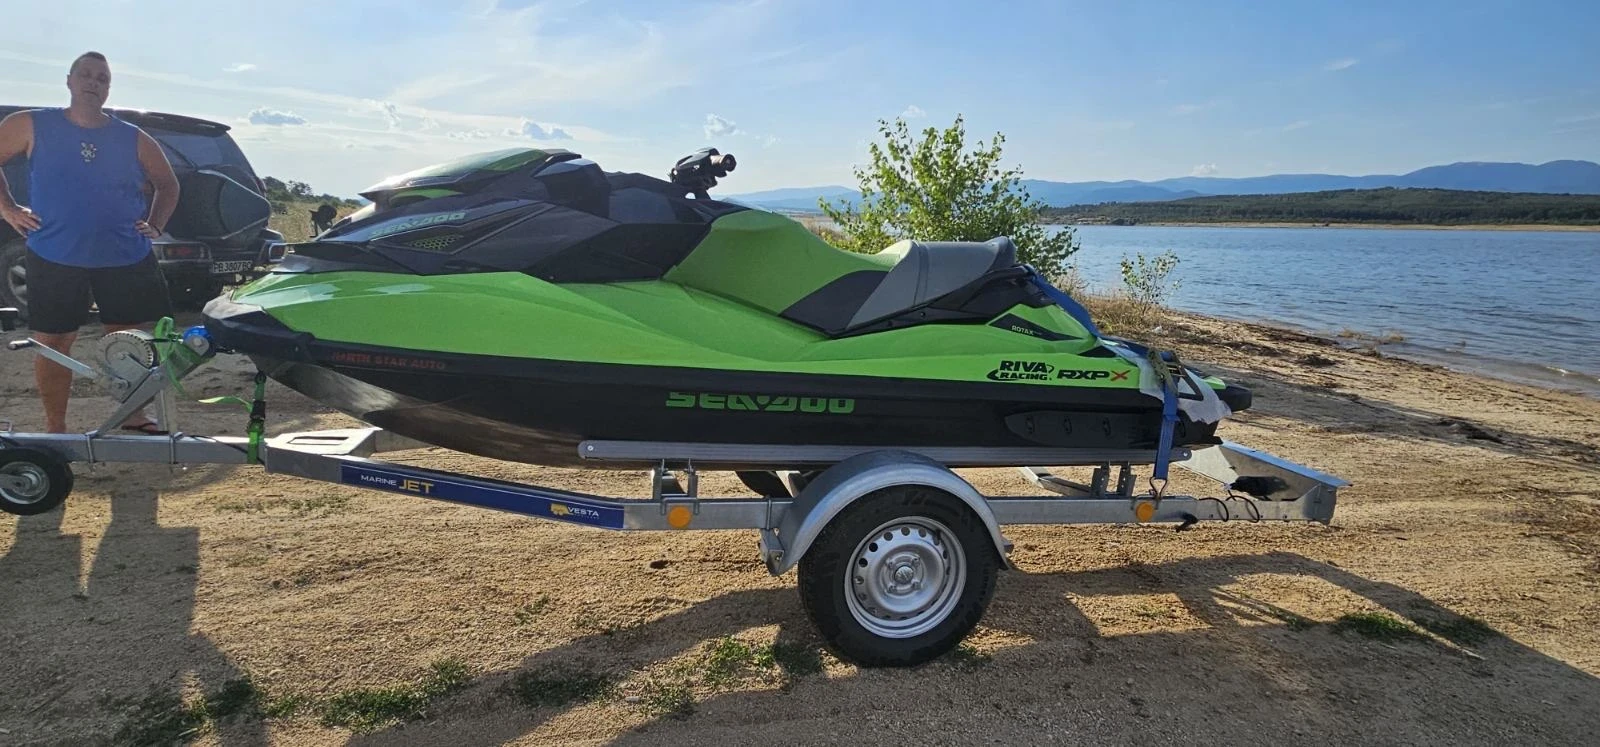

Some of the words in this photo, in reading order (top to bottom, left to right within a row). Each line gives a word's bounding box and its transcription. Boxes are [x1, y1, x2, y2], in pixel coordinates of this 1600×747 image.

[1011, 325, 1034, 336] ROTAX
[375, 355, 406, 367] STAR
[410, 358, 446, 370] AUTO
[999, 360, 1048, 373] RIVA
[360, 475, 397, 486] MARINE
[399, 479, 434, 494] JET
[567, 506, 599, 517] VESTA
